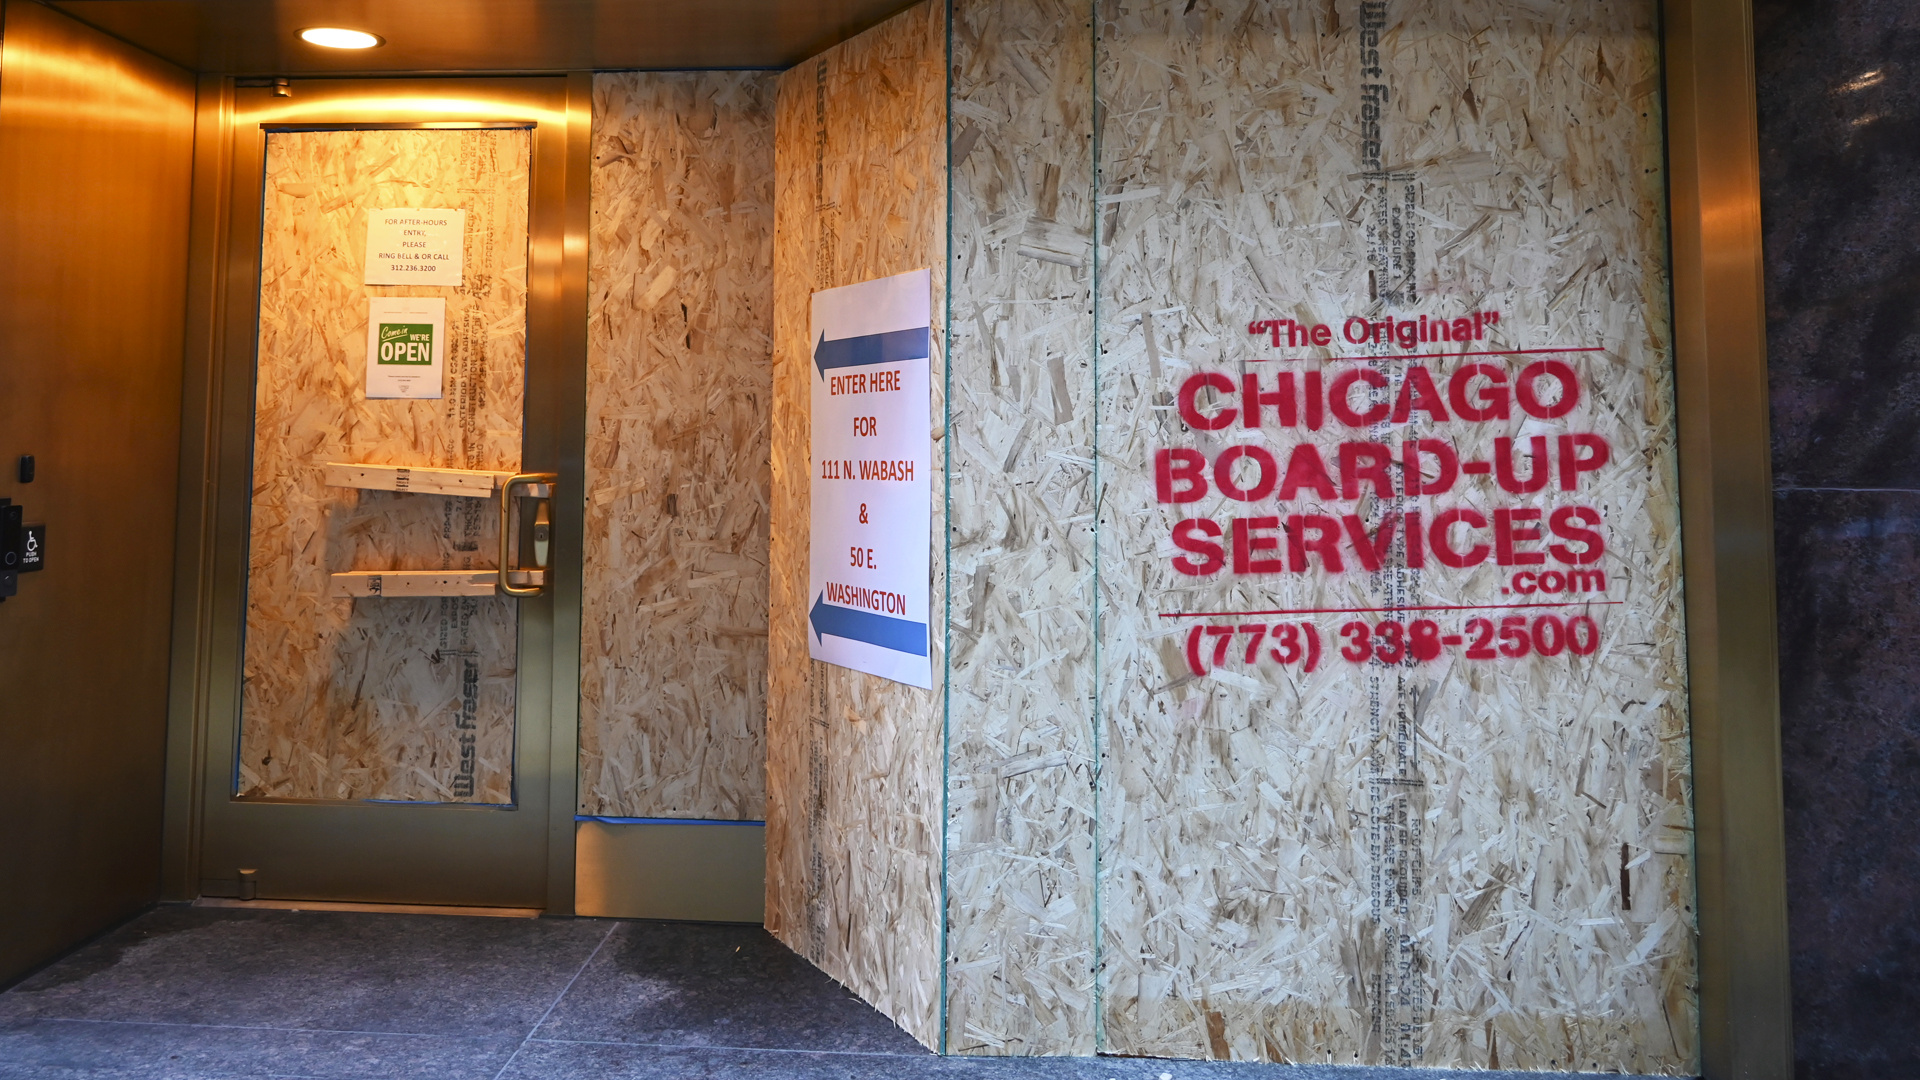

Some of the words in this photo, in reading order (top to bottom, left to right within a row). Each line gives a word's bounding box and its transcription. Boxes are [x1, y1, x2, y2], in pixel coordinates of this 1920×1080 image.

[399, 218, 448, 226] AFTER-HOURS
[1392, 207, 1401, 270] EXPOSURE
[380, 341, 430, 362] OPEN
[409, 333, 430, 342] WE'RE
[830, 375, 867, 396] ENTER
[869, 370, 901, 393] HERE
[1177, 359, 1580, 431] CHICAGO
[853, 416, 877, 438] FOR
[821, 460, 840, 480] 111
[843, 460, 857, 481] N.
[859, 460, 914, 482] WABASH
[1154, 432, 1613, 504] BOARD-UP
[1395, 462, 1404, 526] EXTERIOR
[858, 503, 869, 525] &
[1171, 506, 1606, 577] SERVICES
[1395, 528, 1405, 557] TYPE
[850, 546, 864, 569] 50
[866, 548, 877, 570] E.
[1396, 563, 1405, 623] ADHESIVE
[1500, 569, 1606, 595] .com
[826, 581, 906, 616] WASHINGTON
[1185, 621, 1320, 677] (773)
[1341, 616, 1599, 664] 338-2500
[453, 731, 476, 798] West
